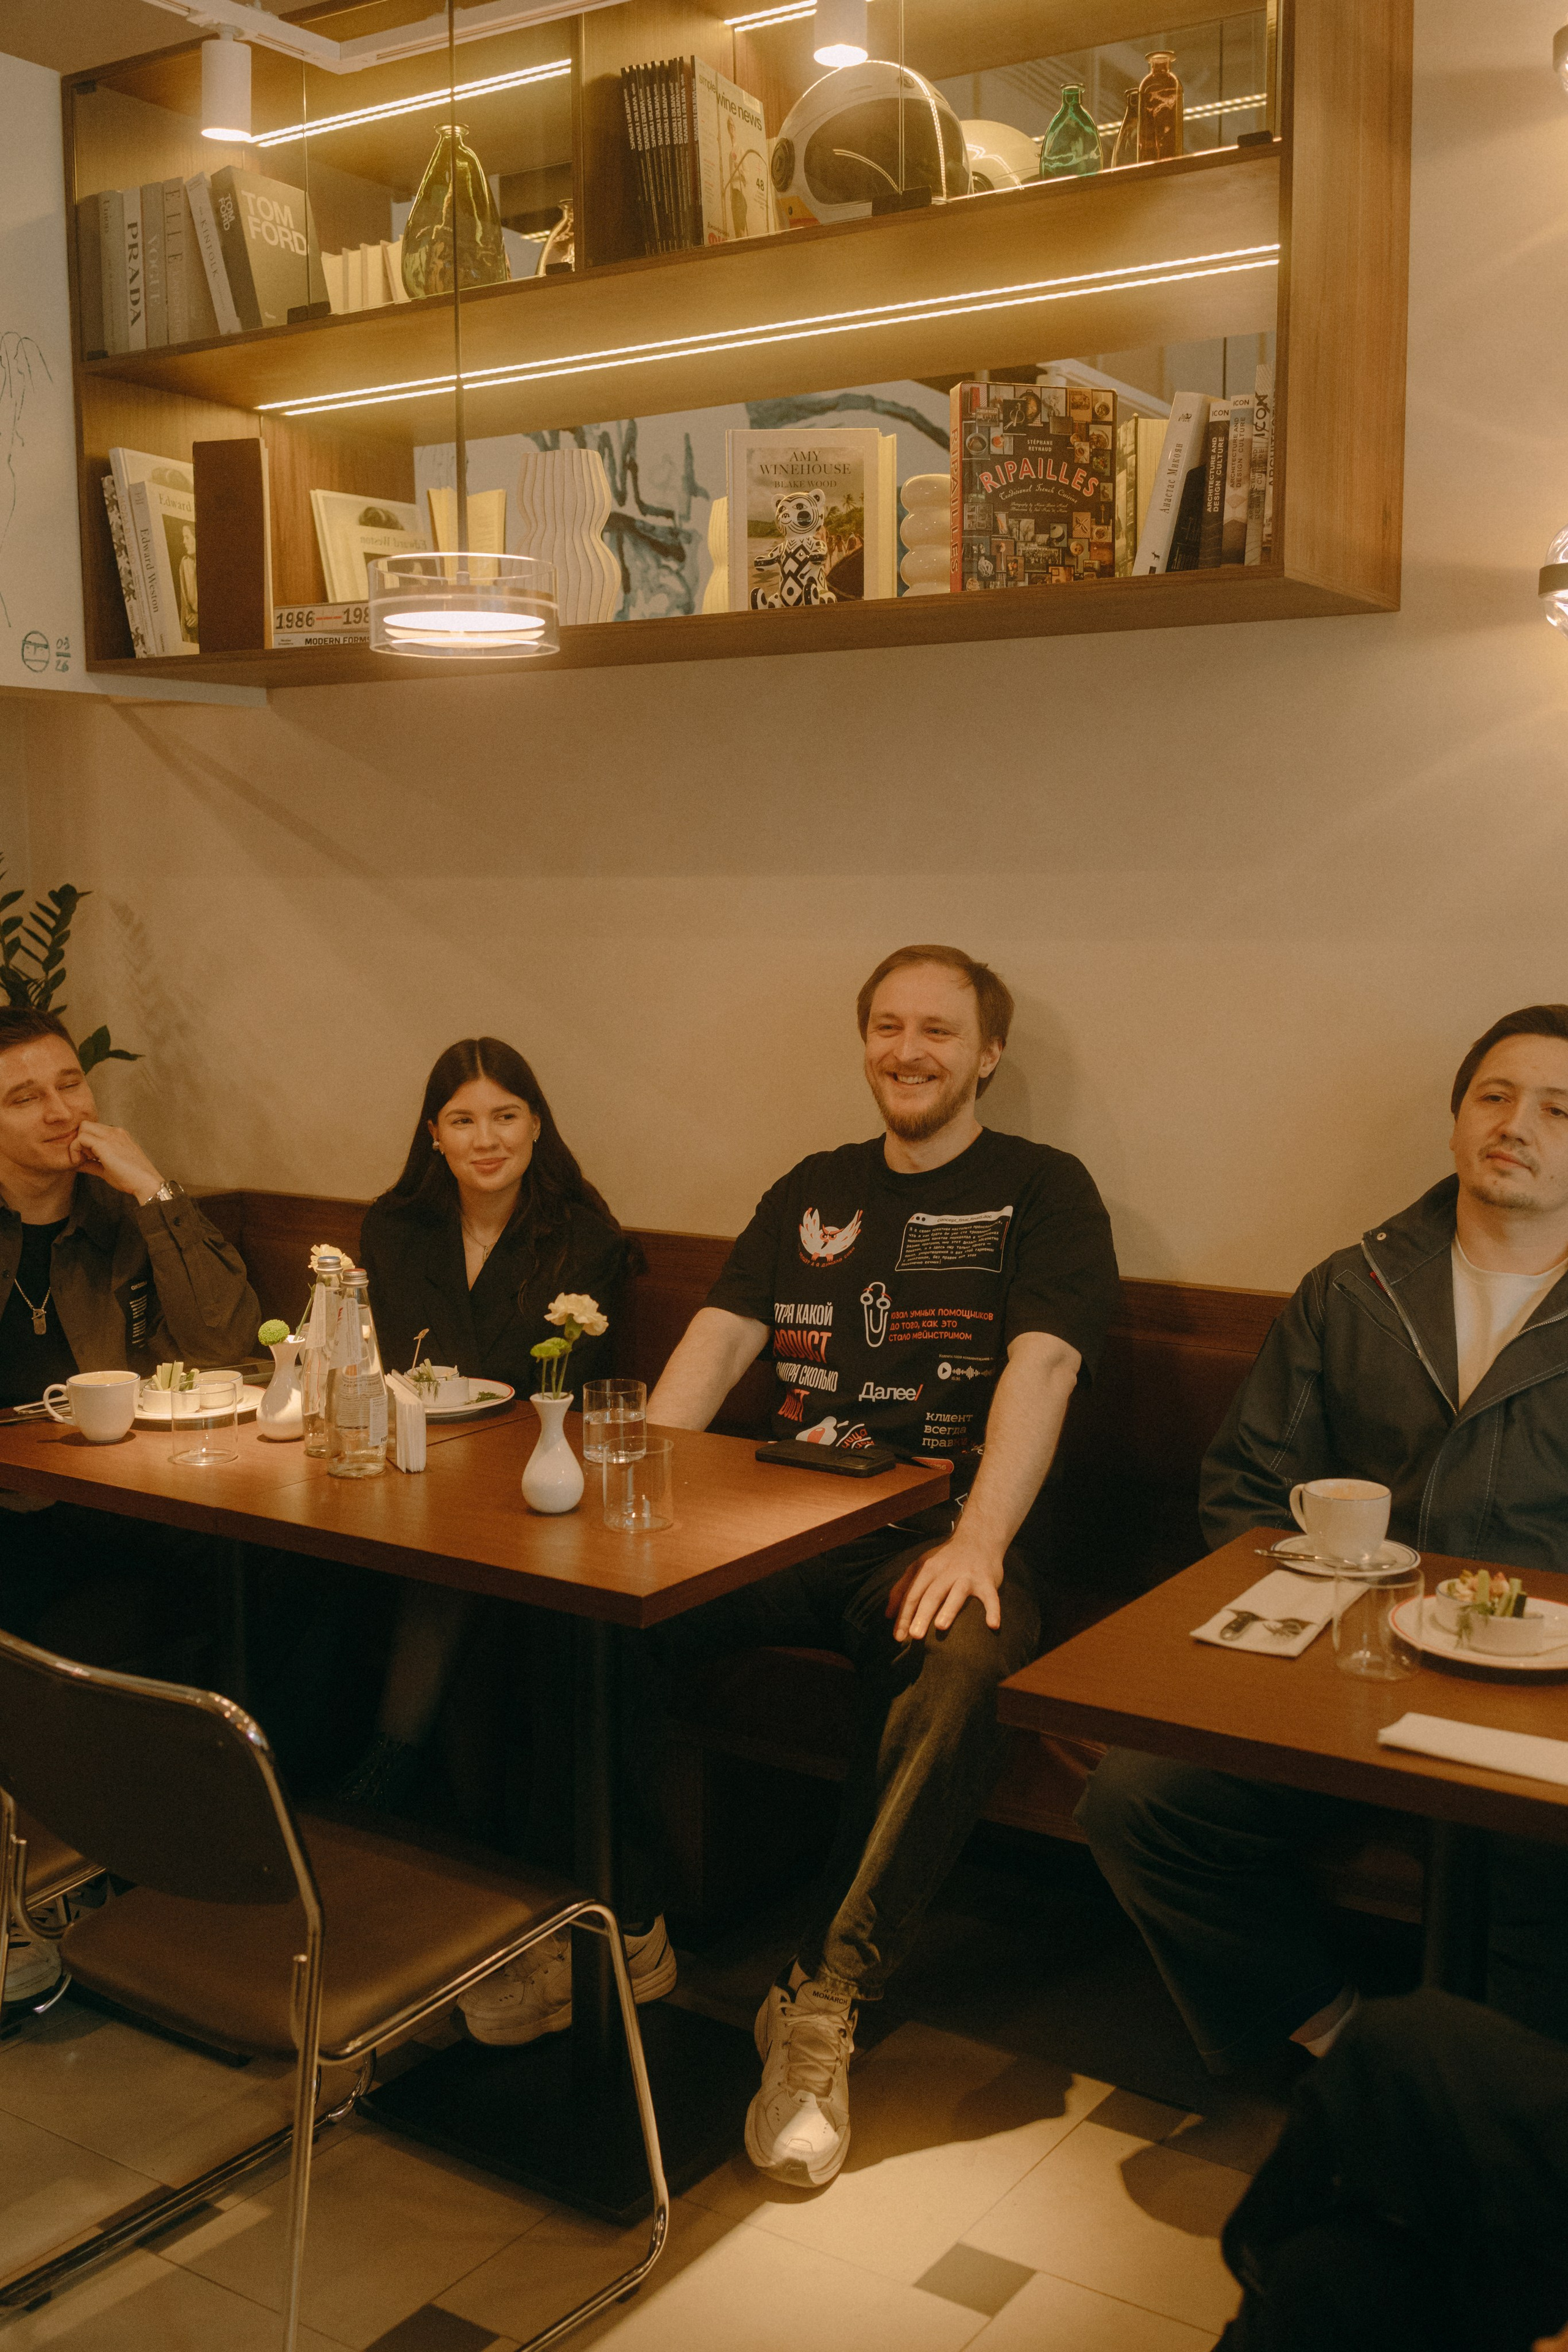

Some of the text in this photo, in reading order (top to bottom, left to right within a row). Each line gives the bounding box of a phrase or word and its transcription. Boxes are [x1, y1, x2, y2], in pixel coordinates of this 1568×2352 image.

[699, 74, 763, 132] simple wine news
[756, 178, 764, 192] 48
[219, 197, 230, 231] FORD
[225, 193, 235, 222] TOM
[241, 190, 295, 229] TOM
[165, 188, 183, 264] ELLE
[247, 216, 307, 256] FORD
[200, 219, 219, 278] KINFOLK
[127, 221, 141, 326] PRADA
[148, 234, 160, 306] VOGUE
[1254, 393, 1270, 437] ICON
[760, 464, 851, 475] WINEHOUSE
[790, 451, 821, 462] AMY
[979, 458, 1099, 497] RIPAILLES
[1161, 443, 1183, 514] Анастас Микоян
[1207, 455, 1216, 513] ARCHITECTURE
[159, 493, 192, 512] Edward
[950, 428, 959, 575] RIPAILLES
[999, 483, 1077, 503] Traditional French Cuisine
[140, 528, 154, 570] Edward
[147, 572, 159, 613] Weston
[276, 610, 315, 630] 1986
[305, 637, 341, 646] MODERN
[774, 1302, 834, 1326] ОТРЯ КАКОЙ
[889, 1322, 900, 1331] до
[902, 1321, 920, 1330] того,
[910, 1309, 935, 1318] умных
[938, 1308, 994, 1321] помощников
[773, 1329, 832, 1363] RODUCT
[889, 1330, 972, 1342] стало мейнстримом
[799, 1365, 839, 1393] СКОЛЬКО
[924, 1425, 967, 1435] всегда
[925, 1412, 973, 1422] клиент
[813, 1991, 848, 2005] MONARCH
